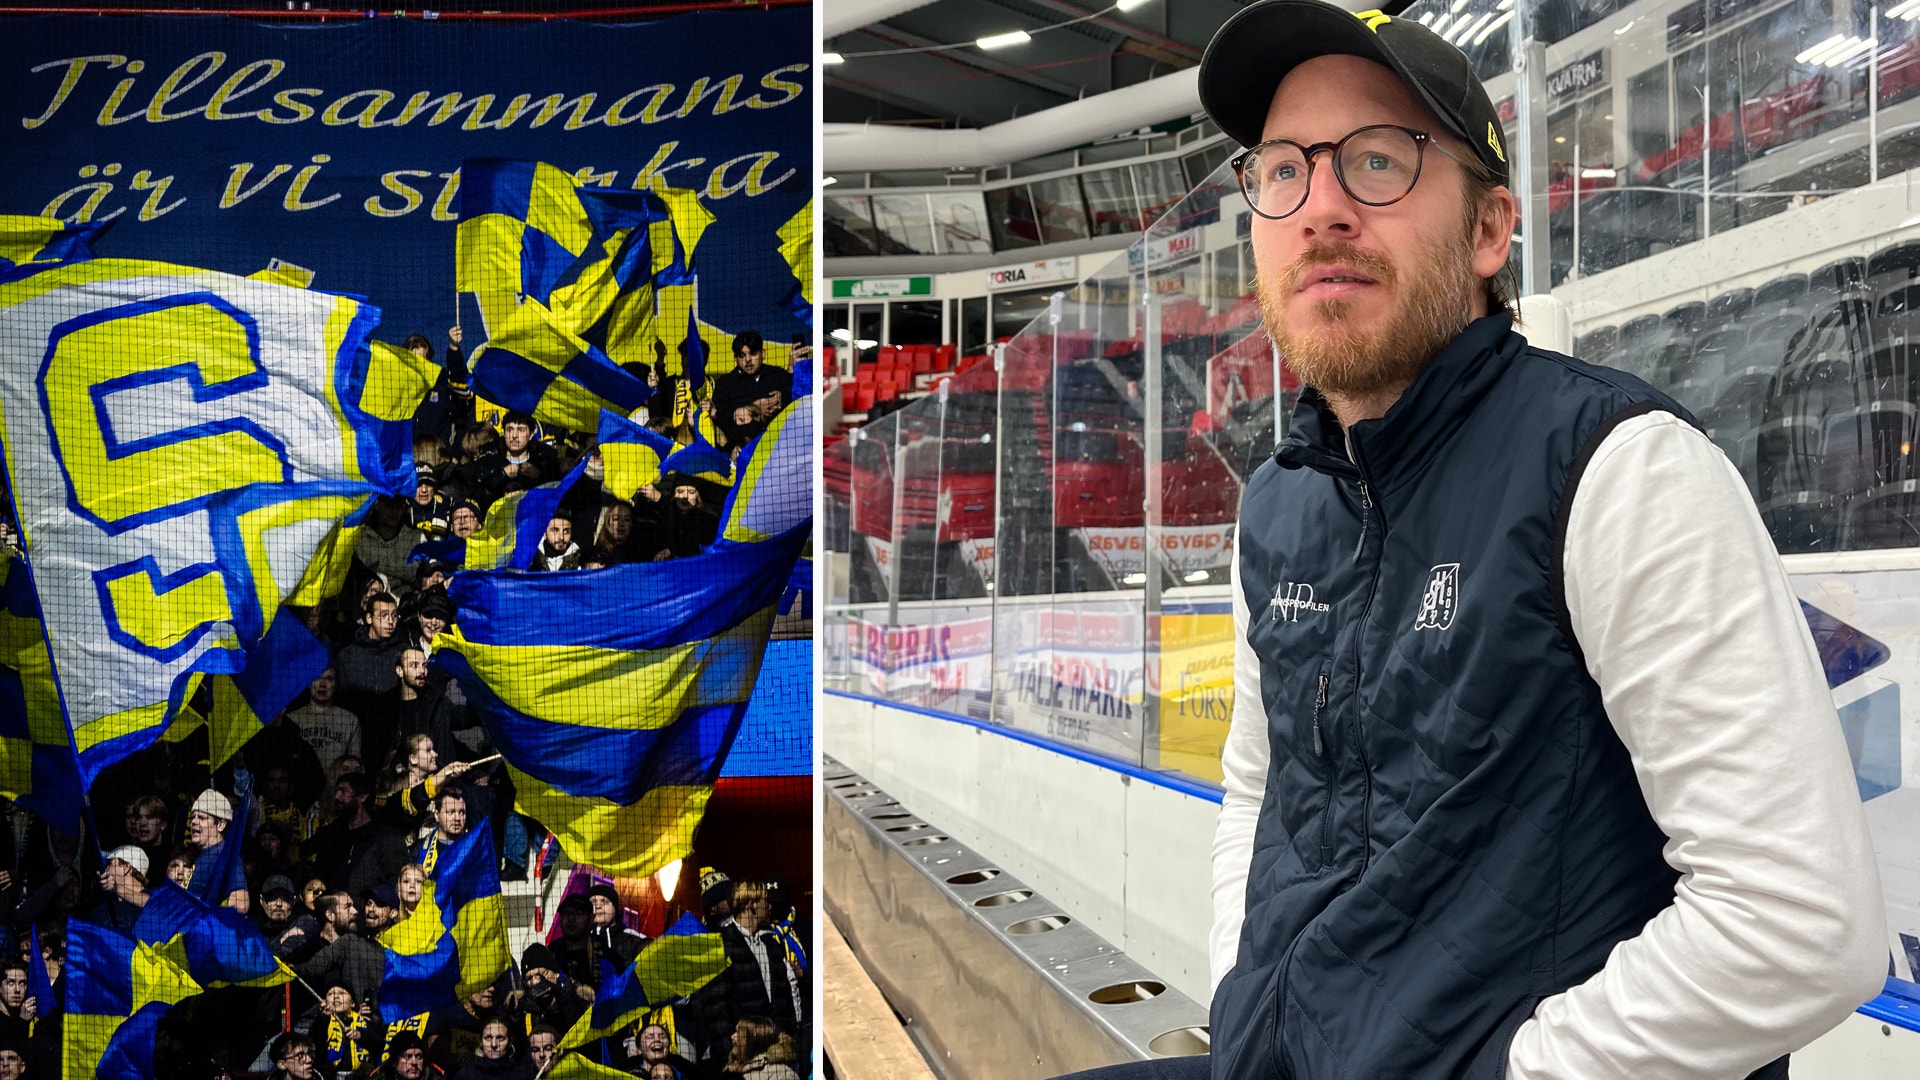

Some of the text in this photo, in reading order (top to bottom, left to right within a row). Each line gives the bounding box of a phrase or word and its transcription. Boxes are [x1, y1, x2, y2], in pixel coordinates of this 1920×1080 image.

[22, 51, 809, 130] Tillsammans
[40, 141, 797, 223] är vi strka
